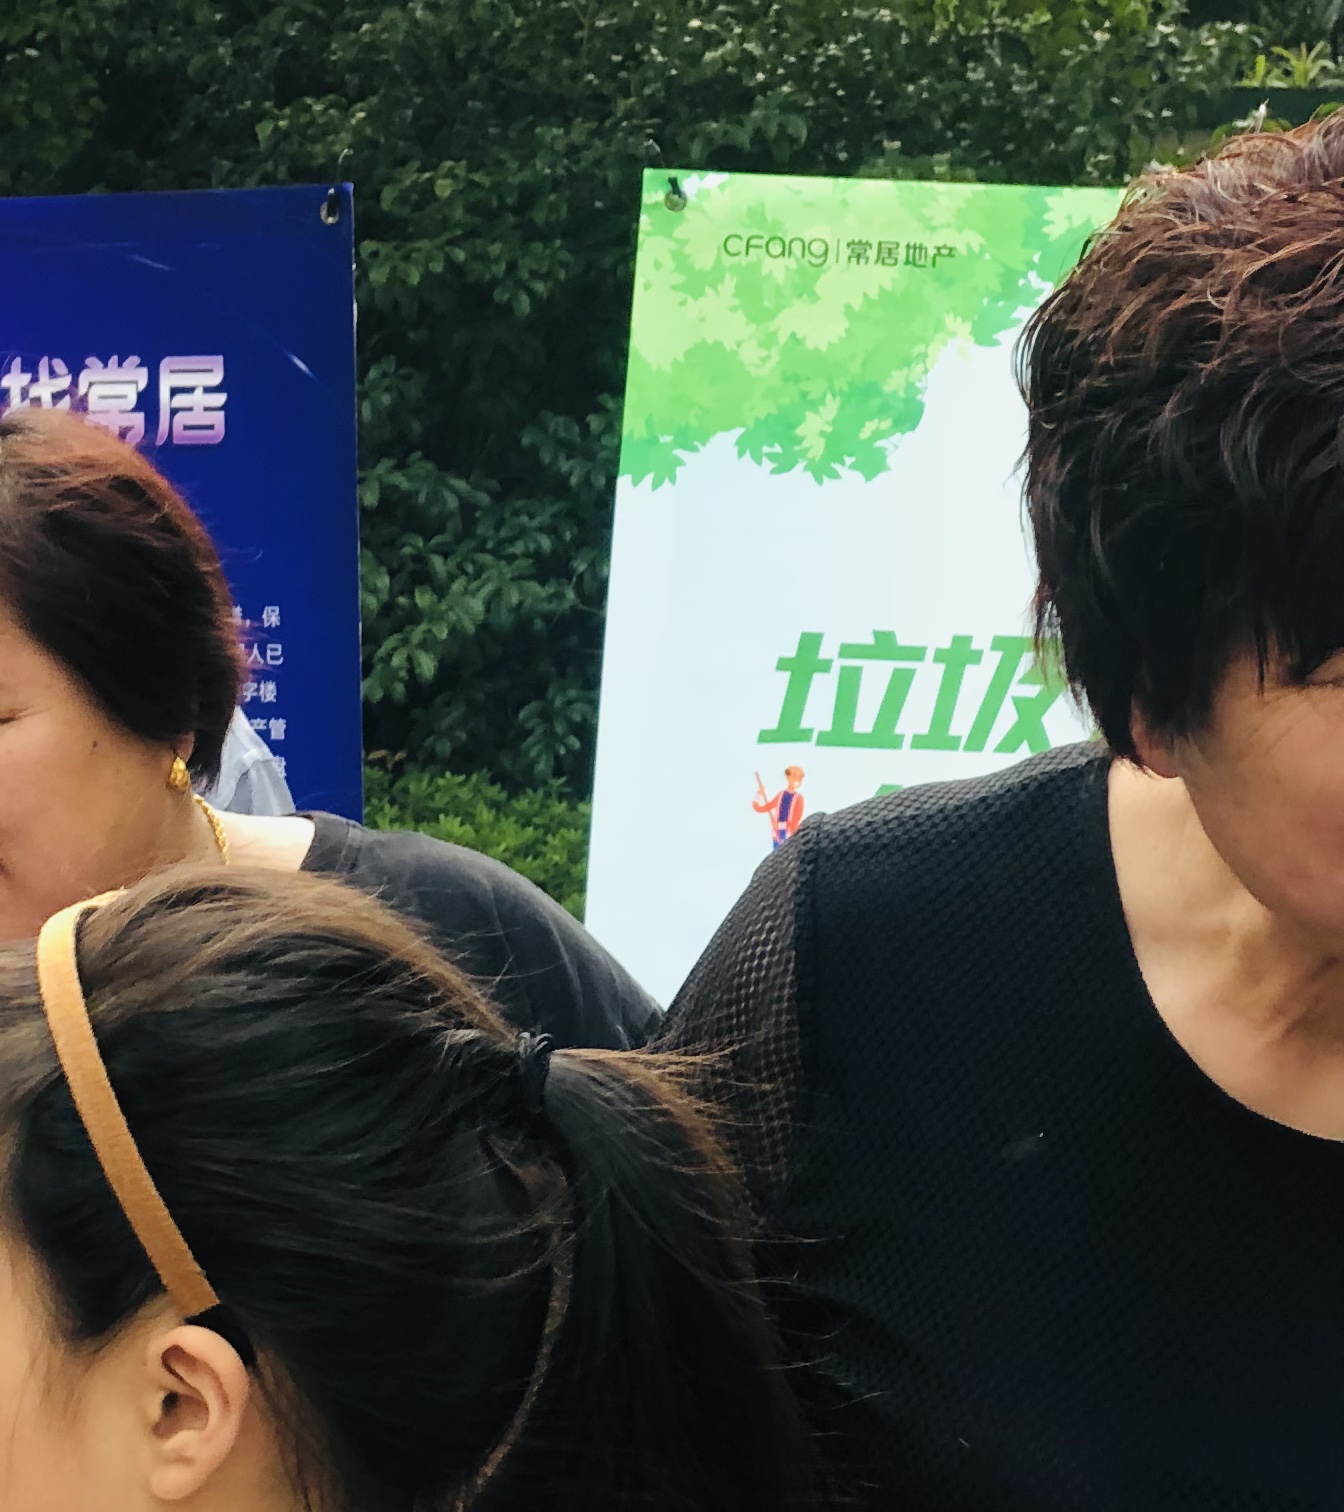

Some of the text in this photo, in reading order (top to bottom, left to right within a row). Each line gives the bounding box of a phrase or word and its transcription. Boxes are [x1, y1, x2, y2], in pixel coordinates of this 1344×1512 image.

[841, 238, 957, 269] 常居地产
[757, 629, 1068, 755] 垃圾
